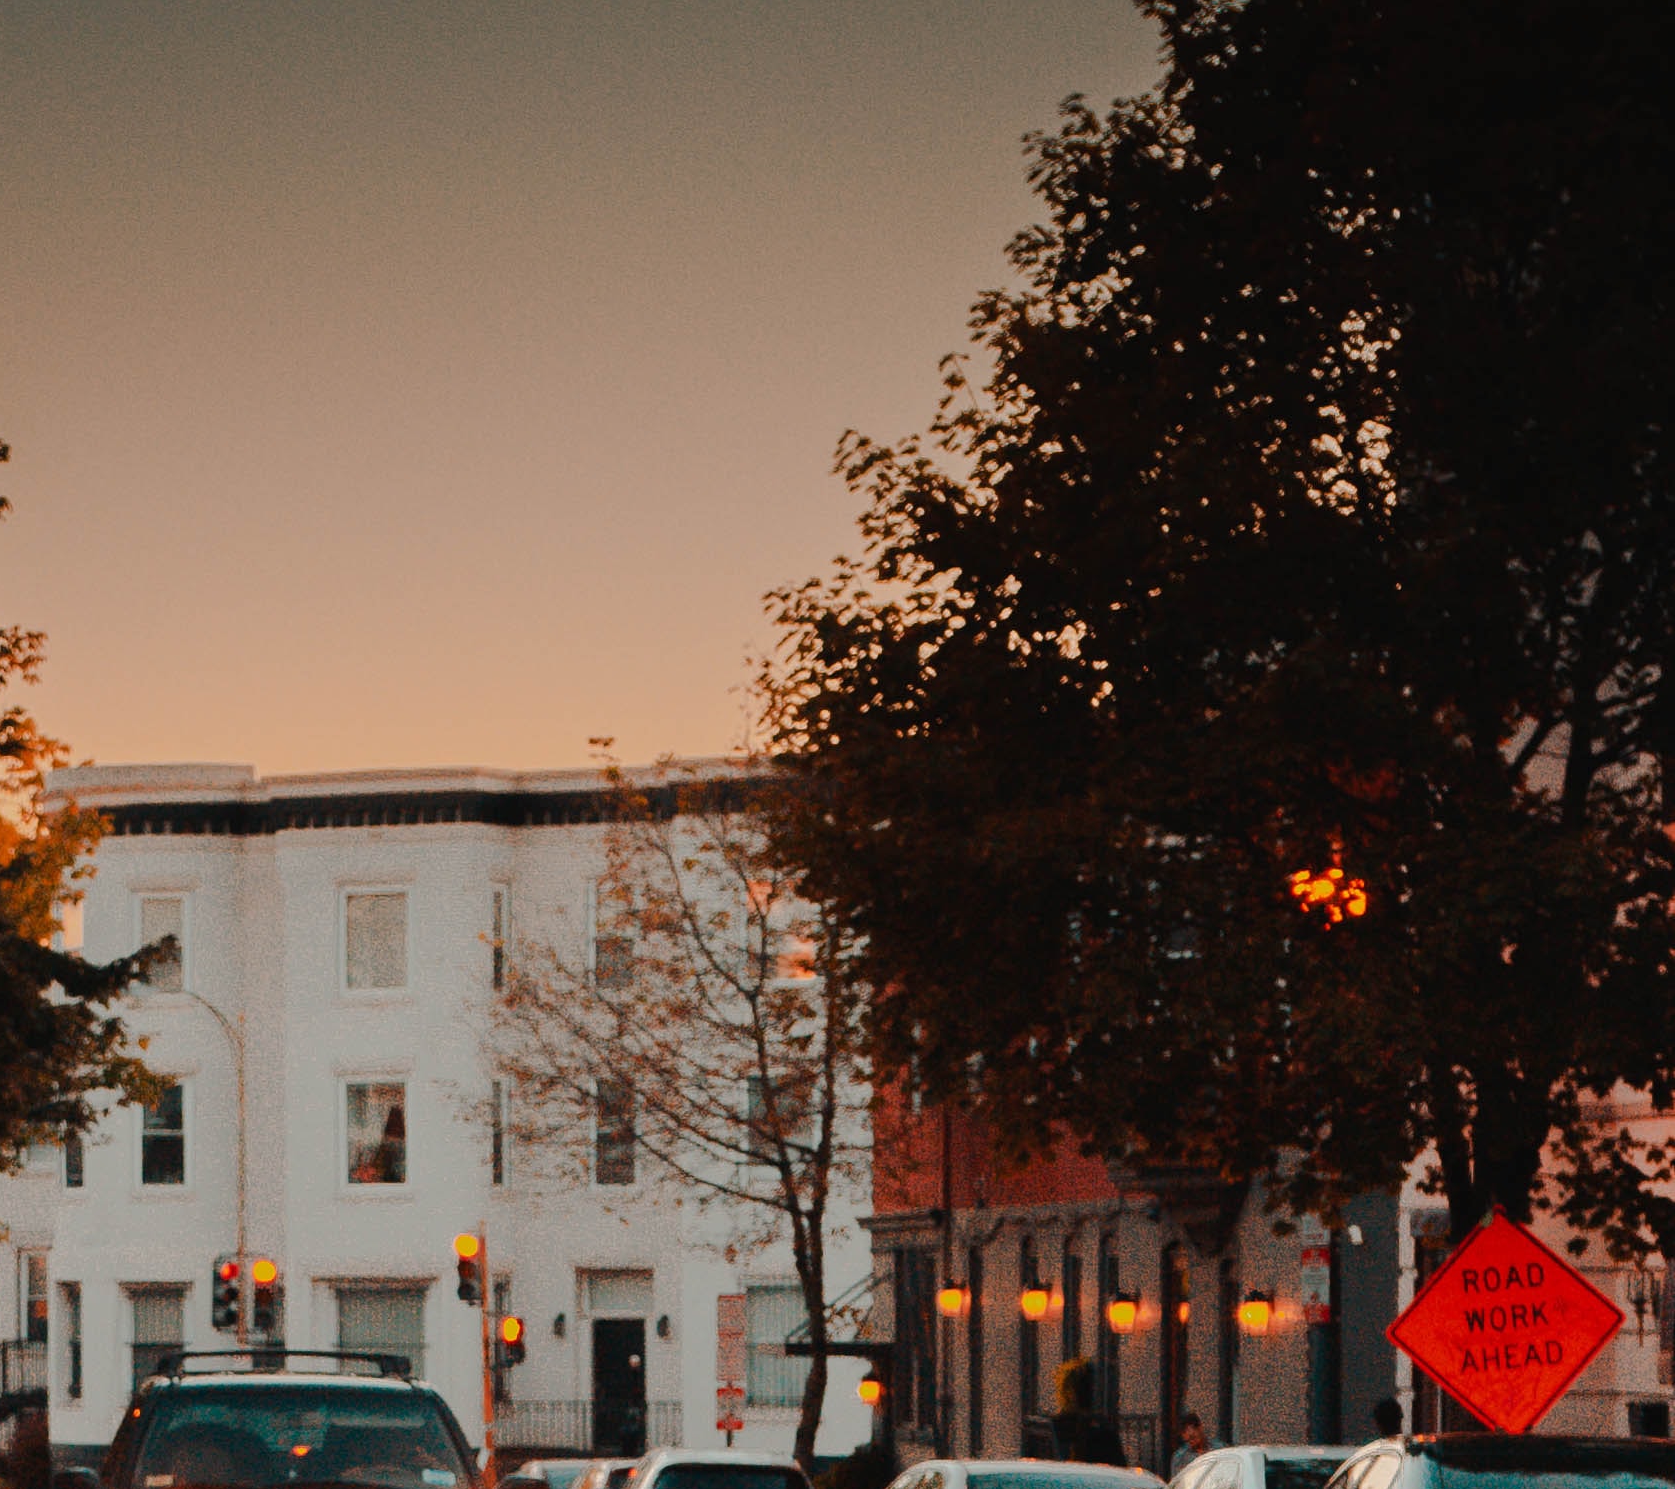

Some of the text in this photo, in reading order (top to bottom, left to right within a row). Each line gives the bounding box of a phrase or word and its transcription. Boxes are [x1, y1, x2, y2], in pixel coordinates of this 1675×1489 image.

[1461, 1262, 1545, 1294] ROAD
[1464, 1302, 1550, 1333] WORK
[1460, 1340, 1564, 1374] AHEAD
